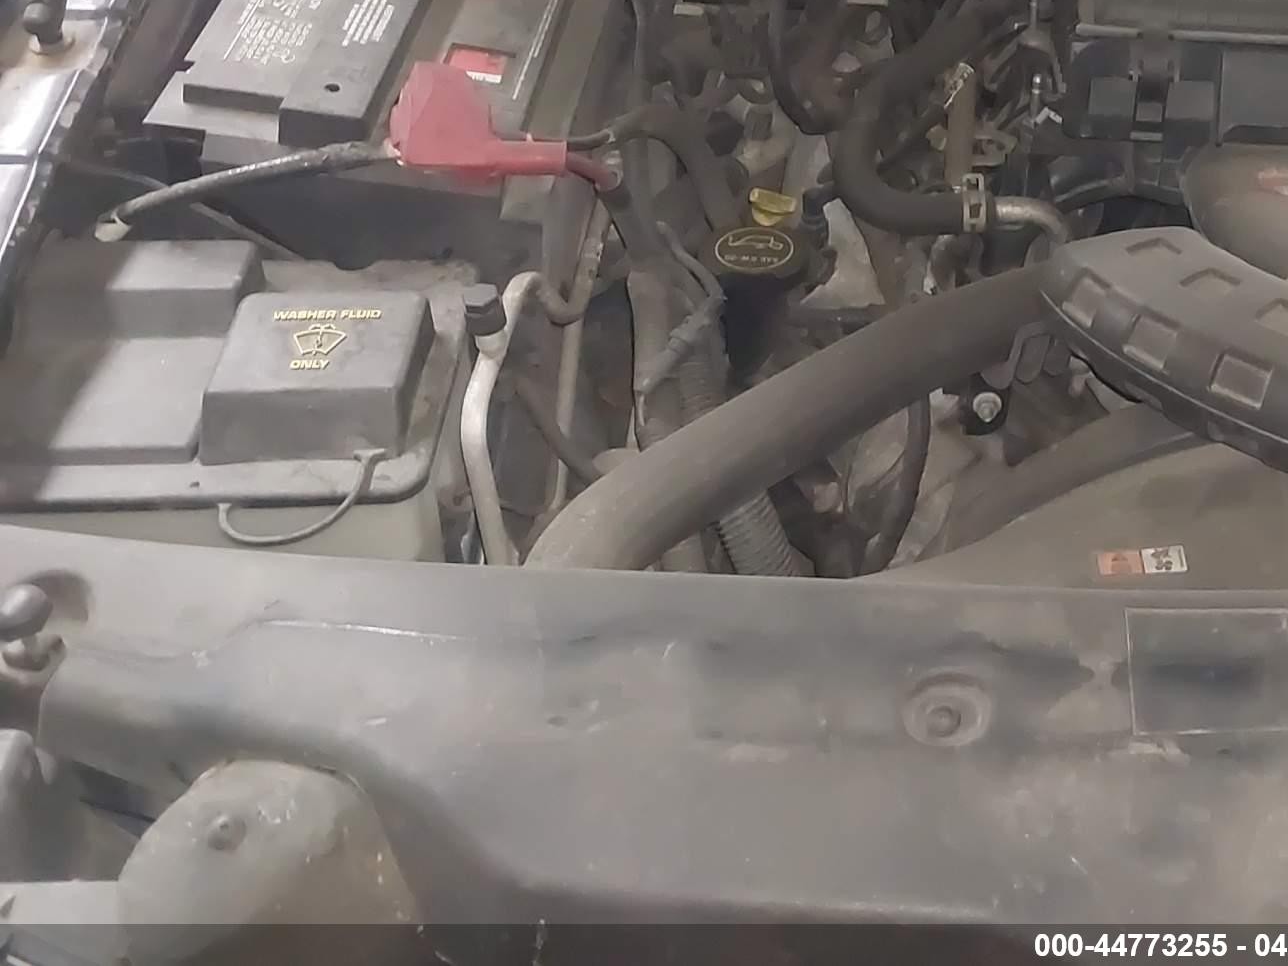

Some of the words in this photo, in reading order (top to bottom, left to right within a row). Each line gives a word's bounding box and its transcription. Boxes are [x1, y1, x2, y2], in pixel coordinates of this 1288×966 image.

[273, 309, 337, 321] WASHER
[340, 309, 382, 320] FLUID
[289, 359, 329, 370] ONLY
